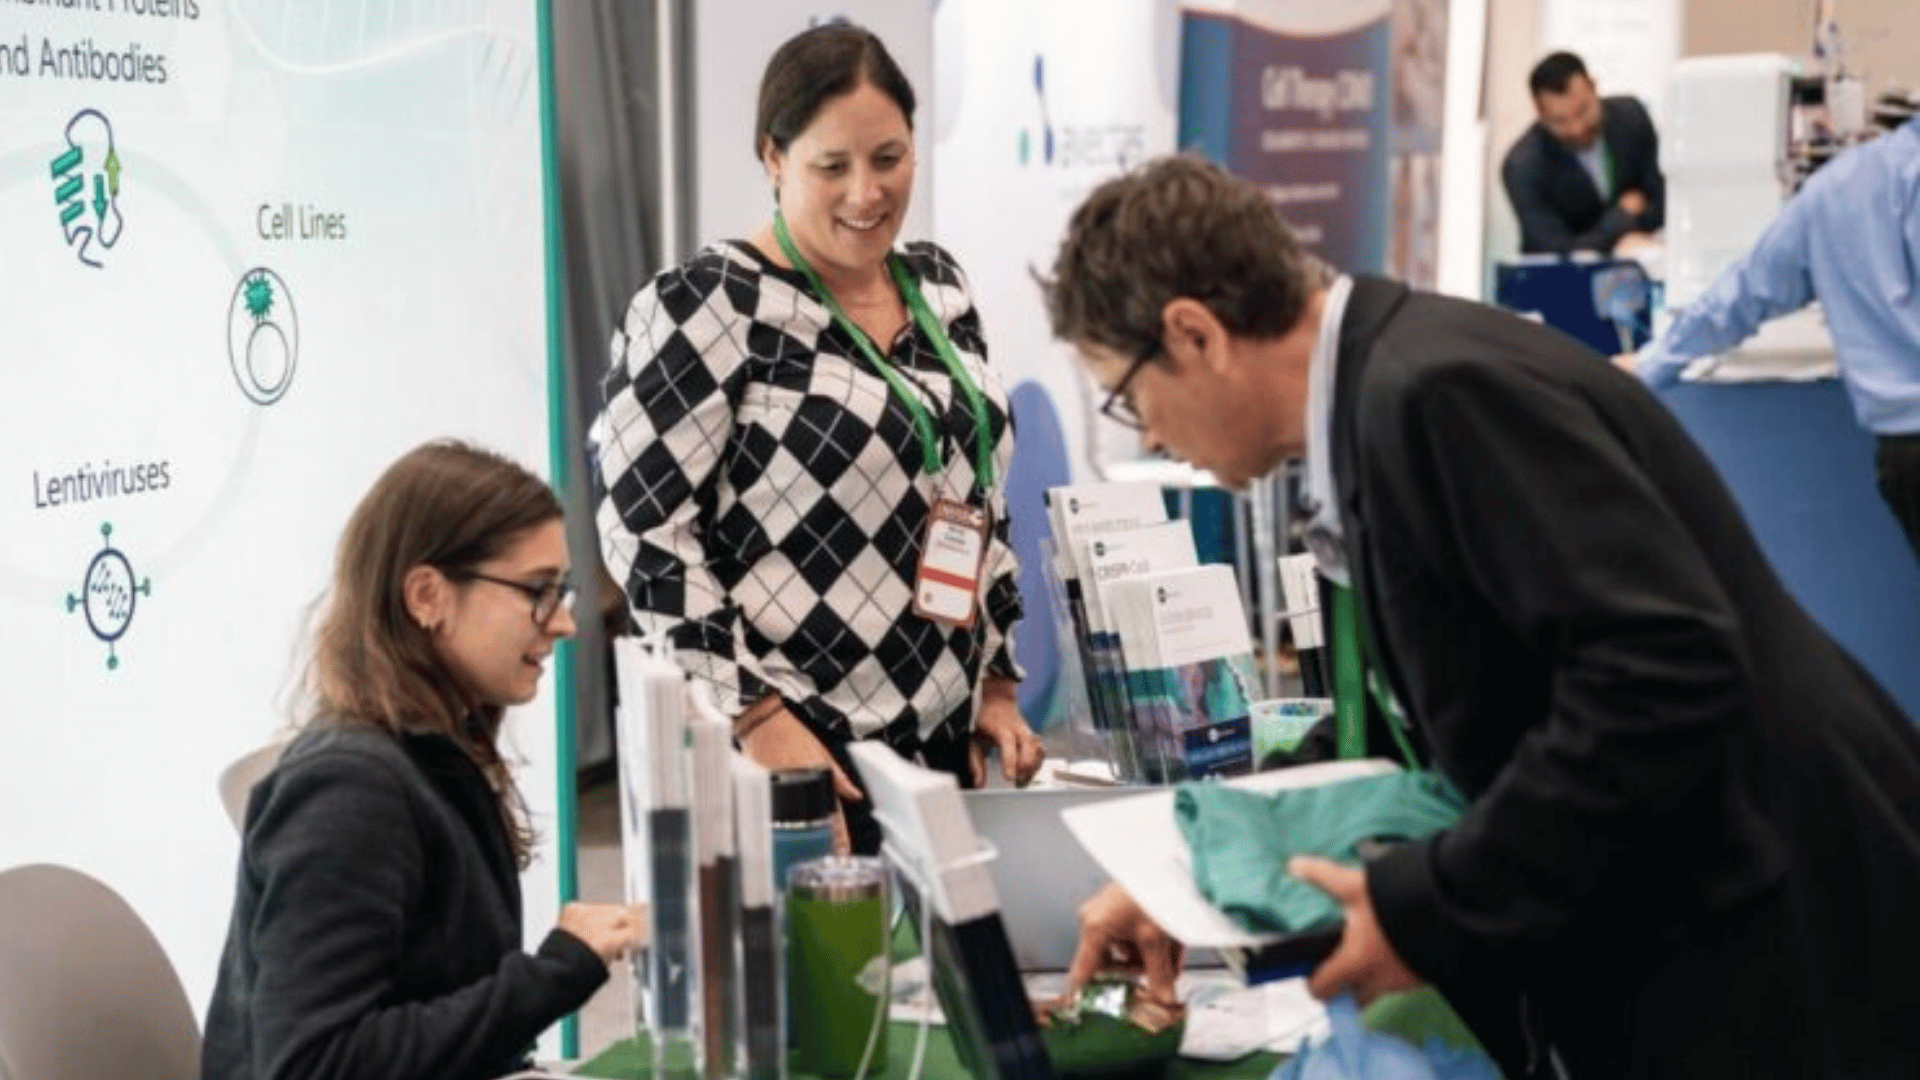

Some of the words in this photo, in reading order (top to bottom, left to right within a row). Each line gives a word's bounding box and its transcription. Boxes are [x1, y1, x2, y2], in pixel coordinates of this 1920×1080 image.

[39, 37, 168, 84] Antibodies
[257, 203, 293, 240] Cell
[298, 203, 347, 240] Lines
[33, 459, 170, 509] Lentiviruses
